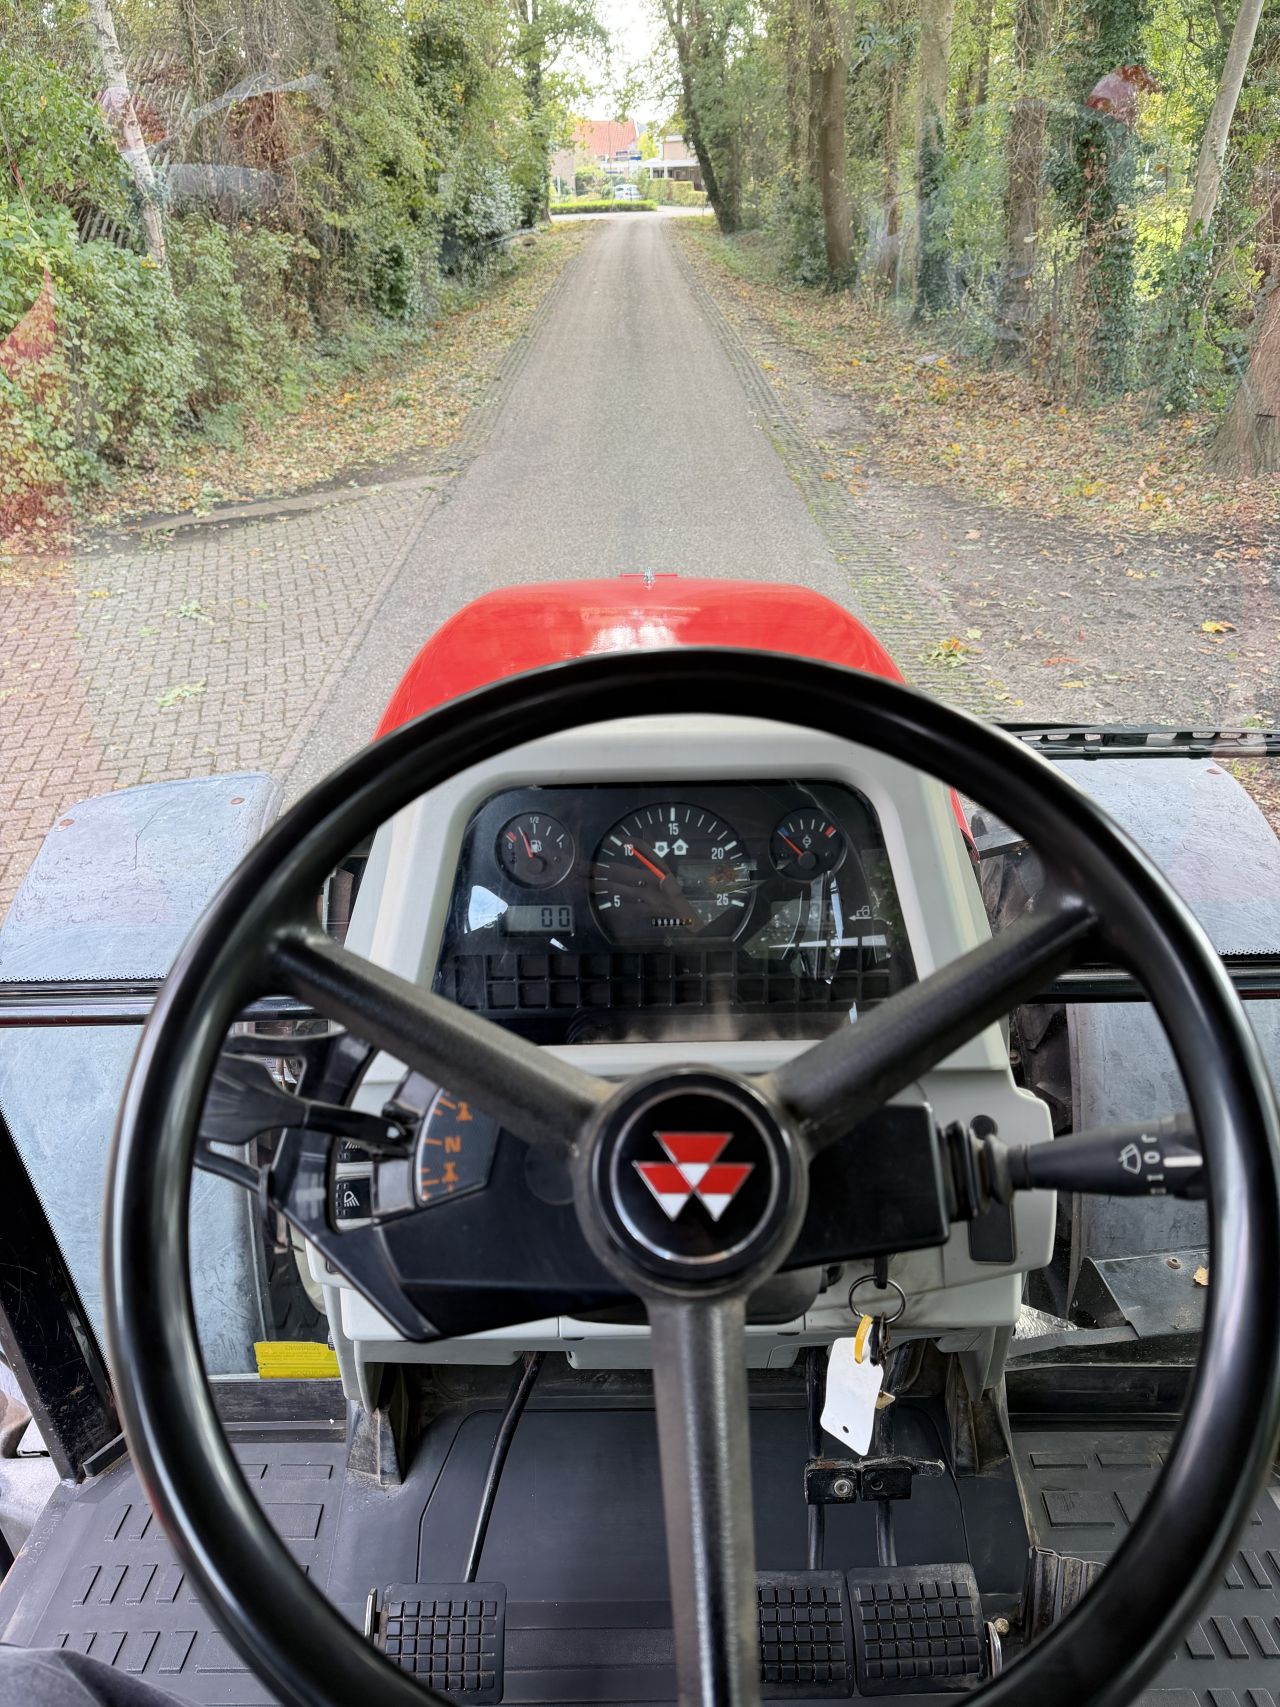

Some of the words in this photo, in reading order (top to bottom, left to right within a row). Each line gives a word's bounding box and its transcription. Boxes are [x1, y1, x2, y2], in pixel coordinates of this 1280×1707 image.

[529, 816, 540, 824] 1/2
[668, 823, 679, 836] 15
[623, 844, 635, 857] 10
[711, 847, 724, 860] 20
[613, 895, 621, 908] 5
[716, 893, 729, 906] 25
[444, 1136, 462, 1154] N
